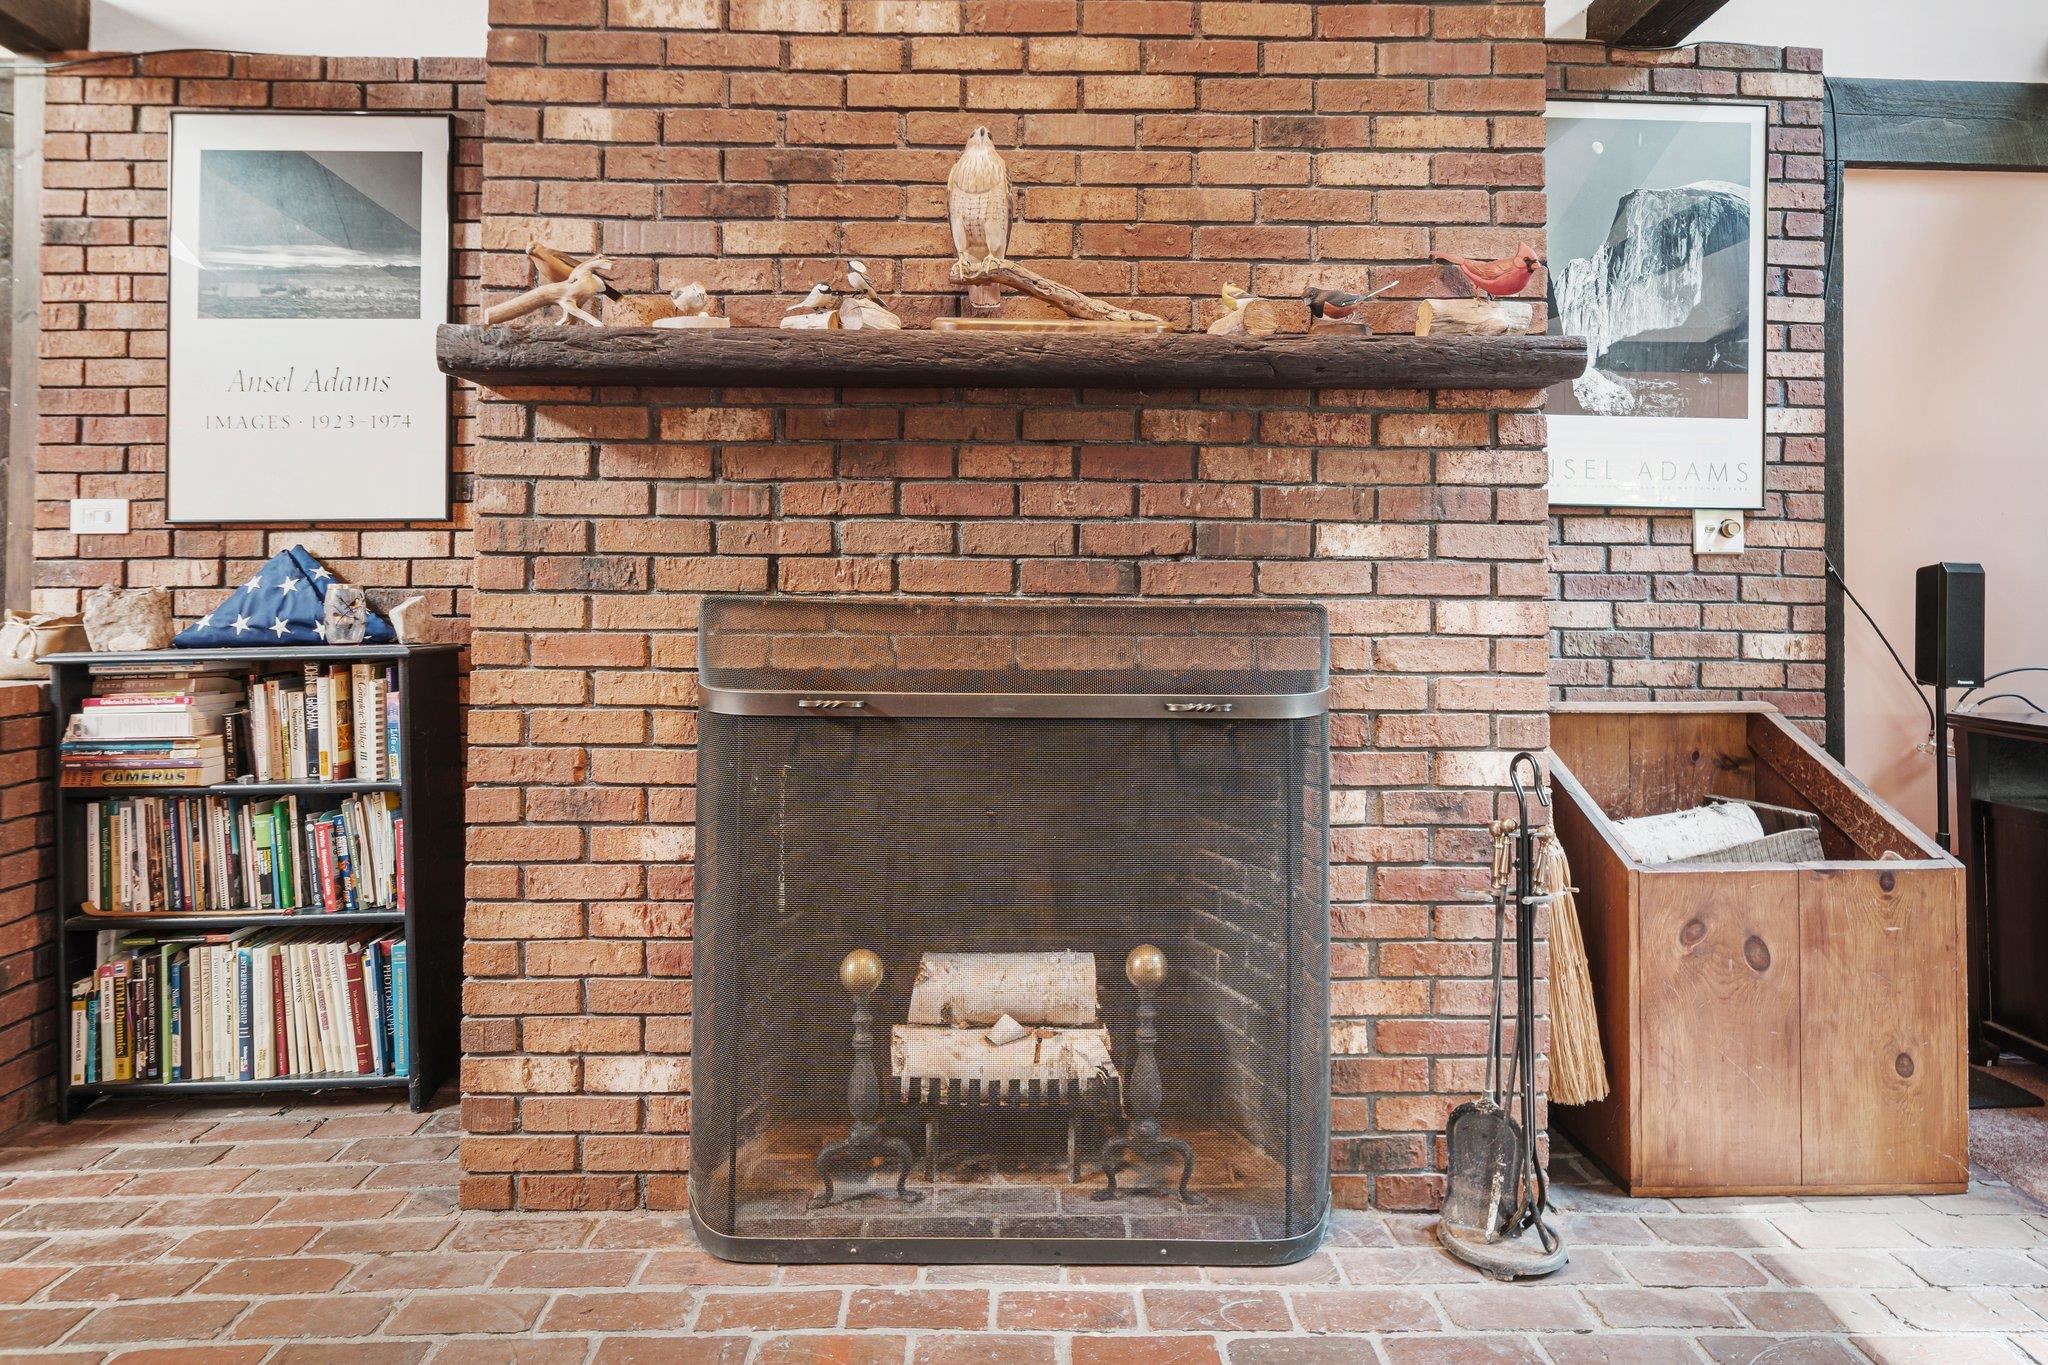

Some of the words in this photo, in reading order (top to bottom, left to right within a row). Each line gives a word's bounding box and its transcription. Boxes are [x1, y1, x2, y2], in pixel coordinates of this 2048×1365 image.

[227, 366, 294, 393] Ansel
[303, 366, 391, 393] Adams
[205, 414, 290, 430] IMAGES
[1638, 460, 1749, 483] ADAMS
[305, 664, 319, 685] JOHN
[305, 697, 319, 730] GRISHAM
[357, 682, 368, 719] Complete
[358, 720, 369, 749] Walker
[389, 728, 398, 745] Life
[101, 770, 186, 783] CAMERAS
[318, 830, 327, 848] White
[320, 848, 331, 878] Mountain
[325, 878, 333, 896] Guide
[116, 977, 126, 1005] HTML
[239, 955, 248, 1024] ENTREPRENEURSHIP
[383, 965, 395, 1037] PHOTOGRAPHY
[75, 1011, 84, 1048] Dreamweaver
[115, 1010, 127, 1055] Dummies
